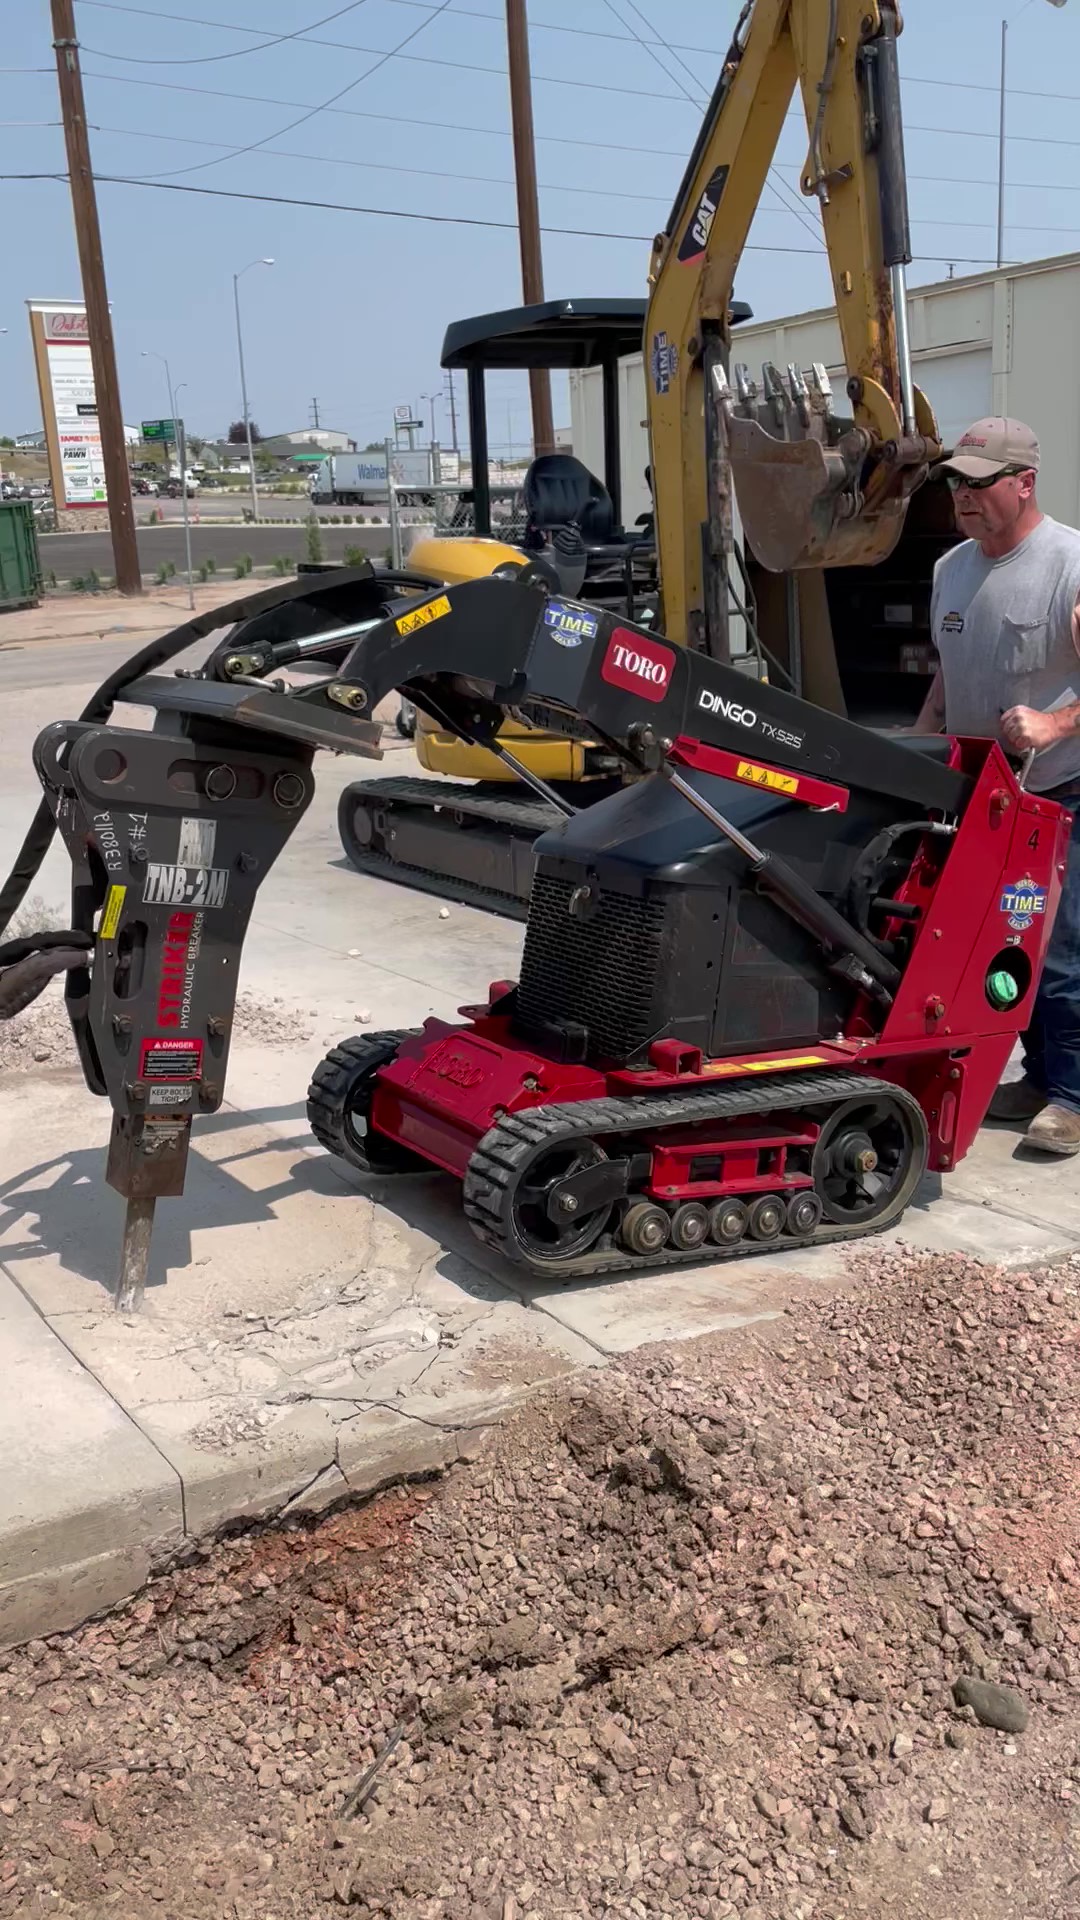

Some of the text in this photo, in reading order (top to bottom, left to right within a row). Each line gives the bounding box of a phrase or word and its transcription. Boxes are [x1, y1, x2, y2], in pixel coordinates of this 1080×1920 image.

[692, 191, 716, 246] CAT
[658, 334, 668, 392] TIME
[548, 610, 593, 635] TIME
[699, 690, 757, 728] DINGO
[127, 811, 149, 841] #1
[1028, 829, 1040, 850] 4
[147, 865, 226, 906] TNB-2M
[1004, 895, 1045, 911] TIME
[157, 911, 195, 1028] STRIKER
[180, 911, 205, 1029] HYDRAULIC BREAKER
[162, 1041, 194, 1049] DANGER
